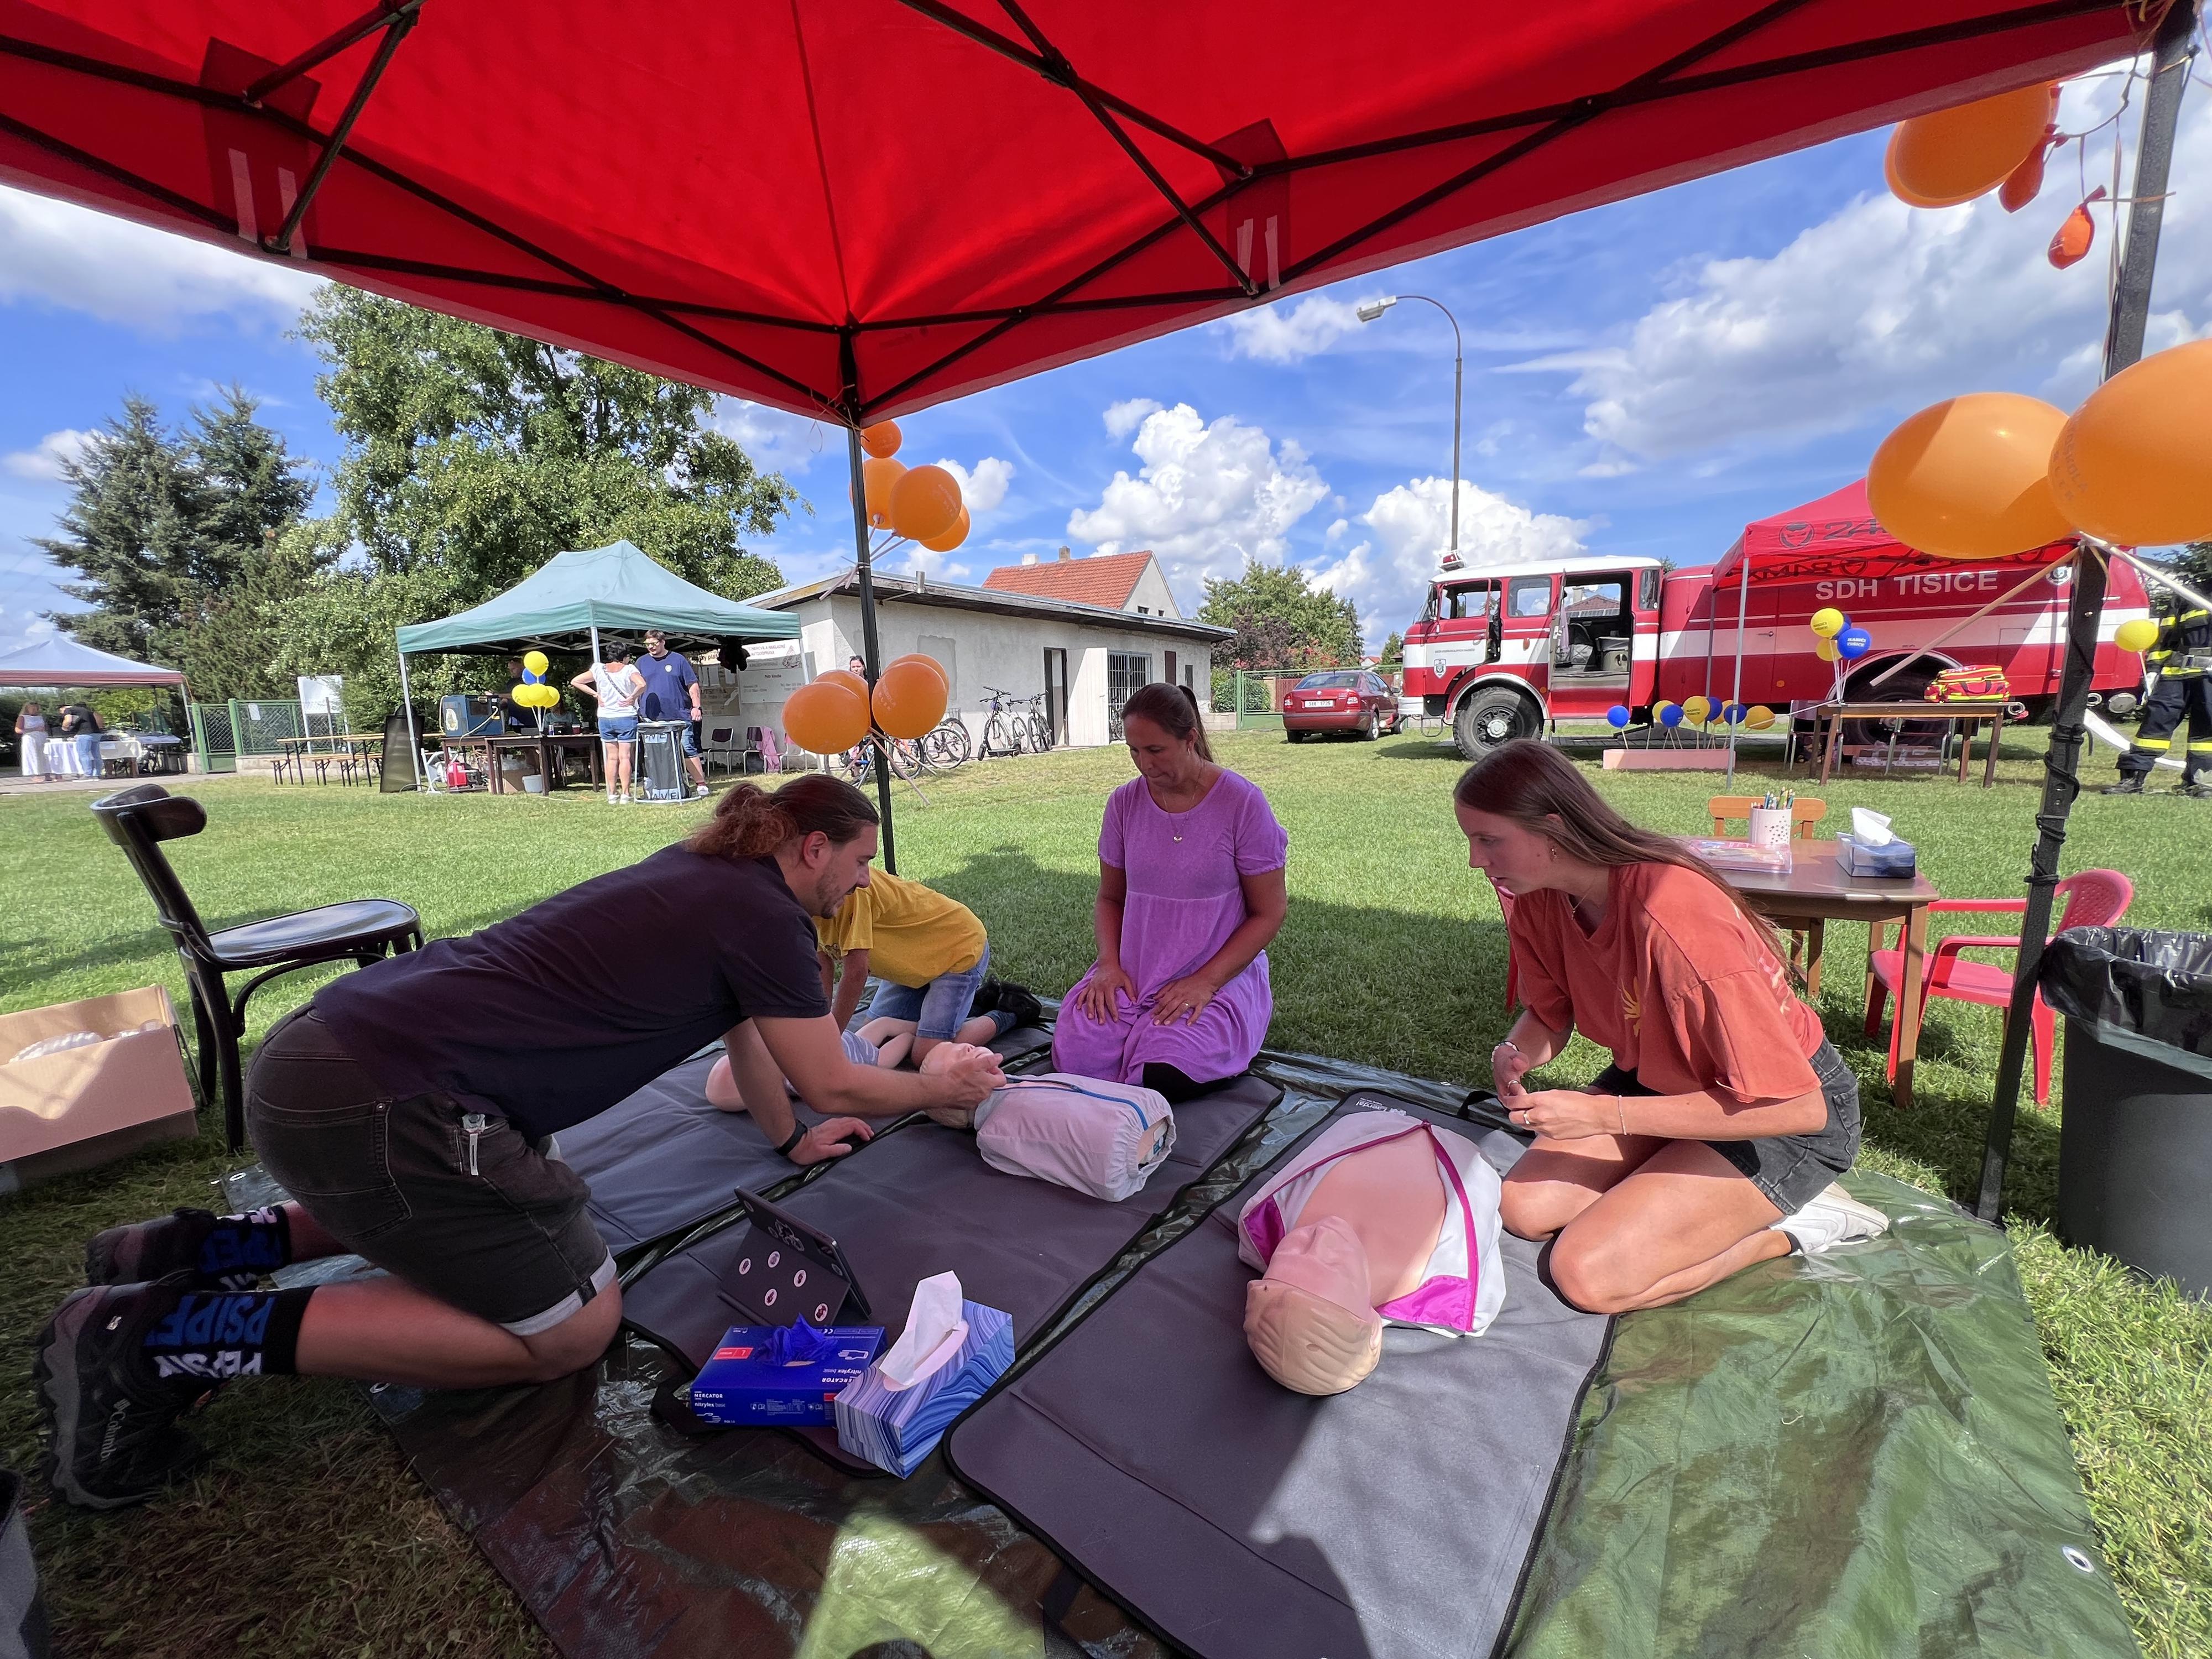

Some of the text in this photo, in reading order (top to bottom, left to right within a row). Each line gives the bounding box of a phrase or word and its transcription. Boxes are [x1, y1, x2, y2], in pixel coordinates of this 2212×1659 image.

[1822, 518, 1888, 541] 24
[1815, 579, 1877, 600] SDH
[1355, 1100, 1387, 1112] Laerdal
